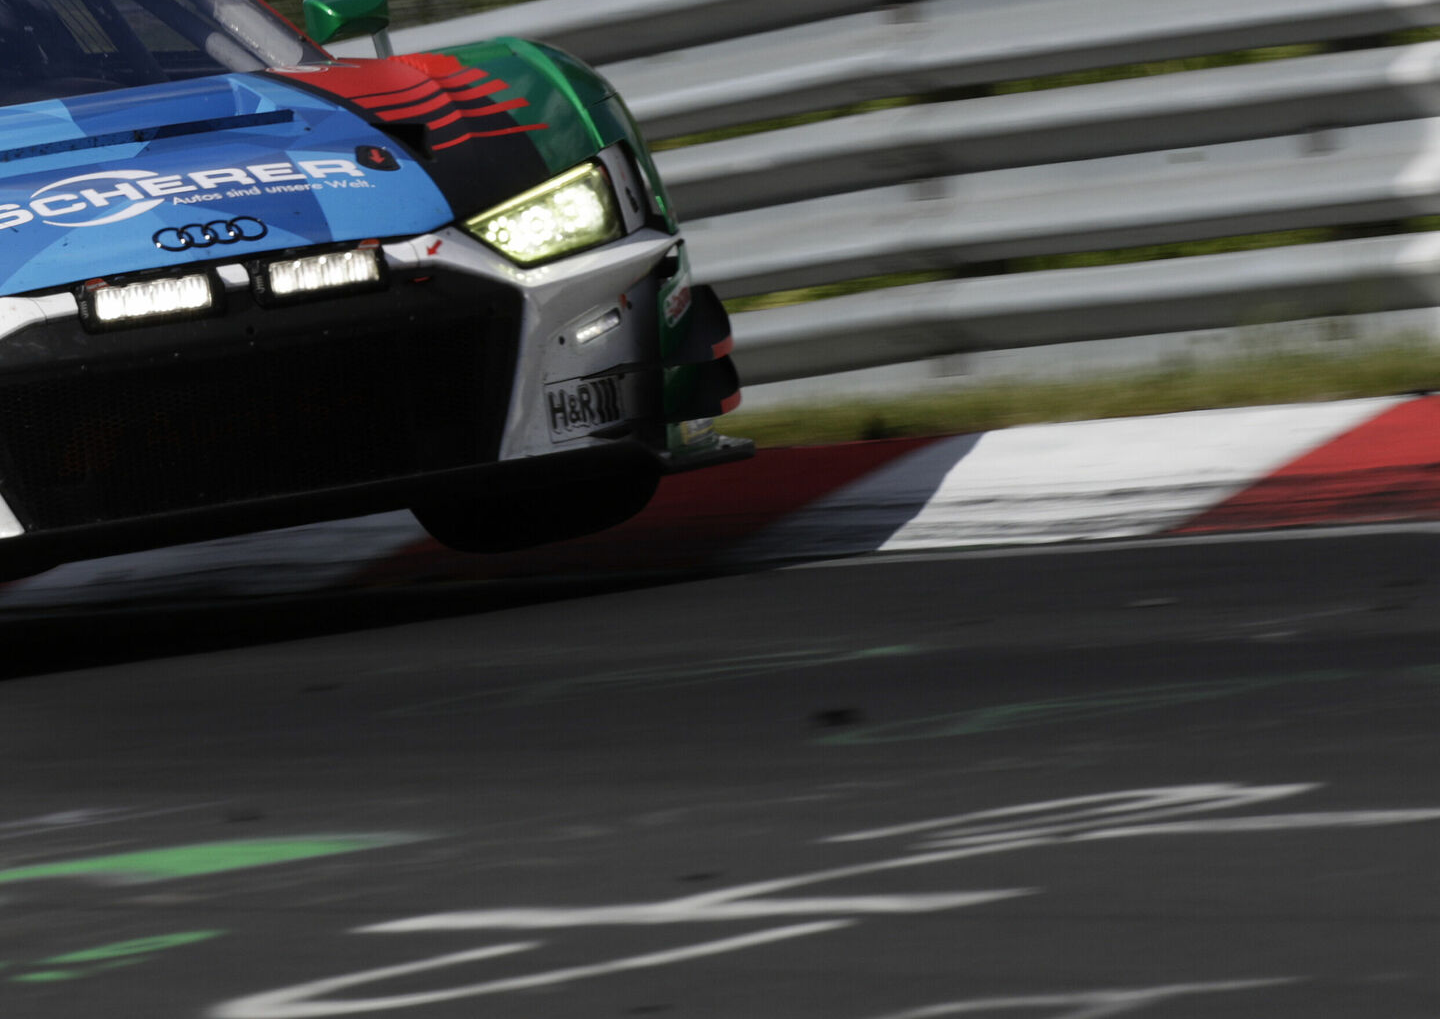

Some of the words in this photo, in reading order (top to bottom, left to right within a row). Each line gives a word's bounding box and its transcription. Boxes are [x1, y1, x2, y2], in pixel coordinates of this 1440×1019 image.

[172, 191, 223, 206] Autos
[226, 185, 262, 198] sind
[264, 180, 323, 195] unsere
[547, 384, 596, 431] H&R
